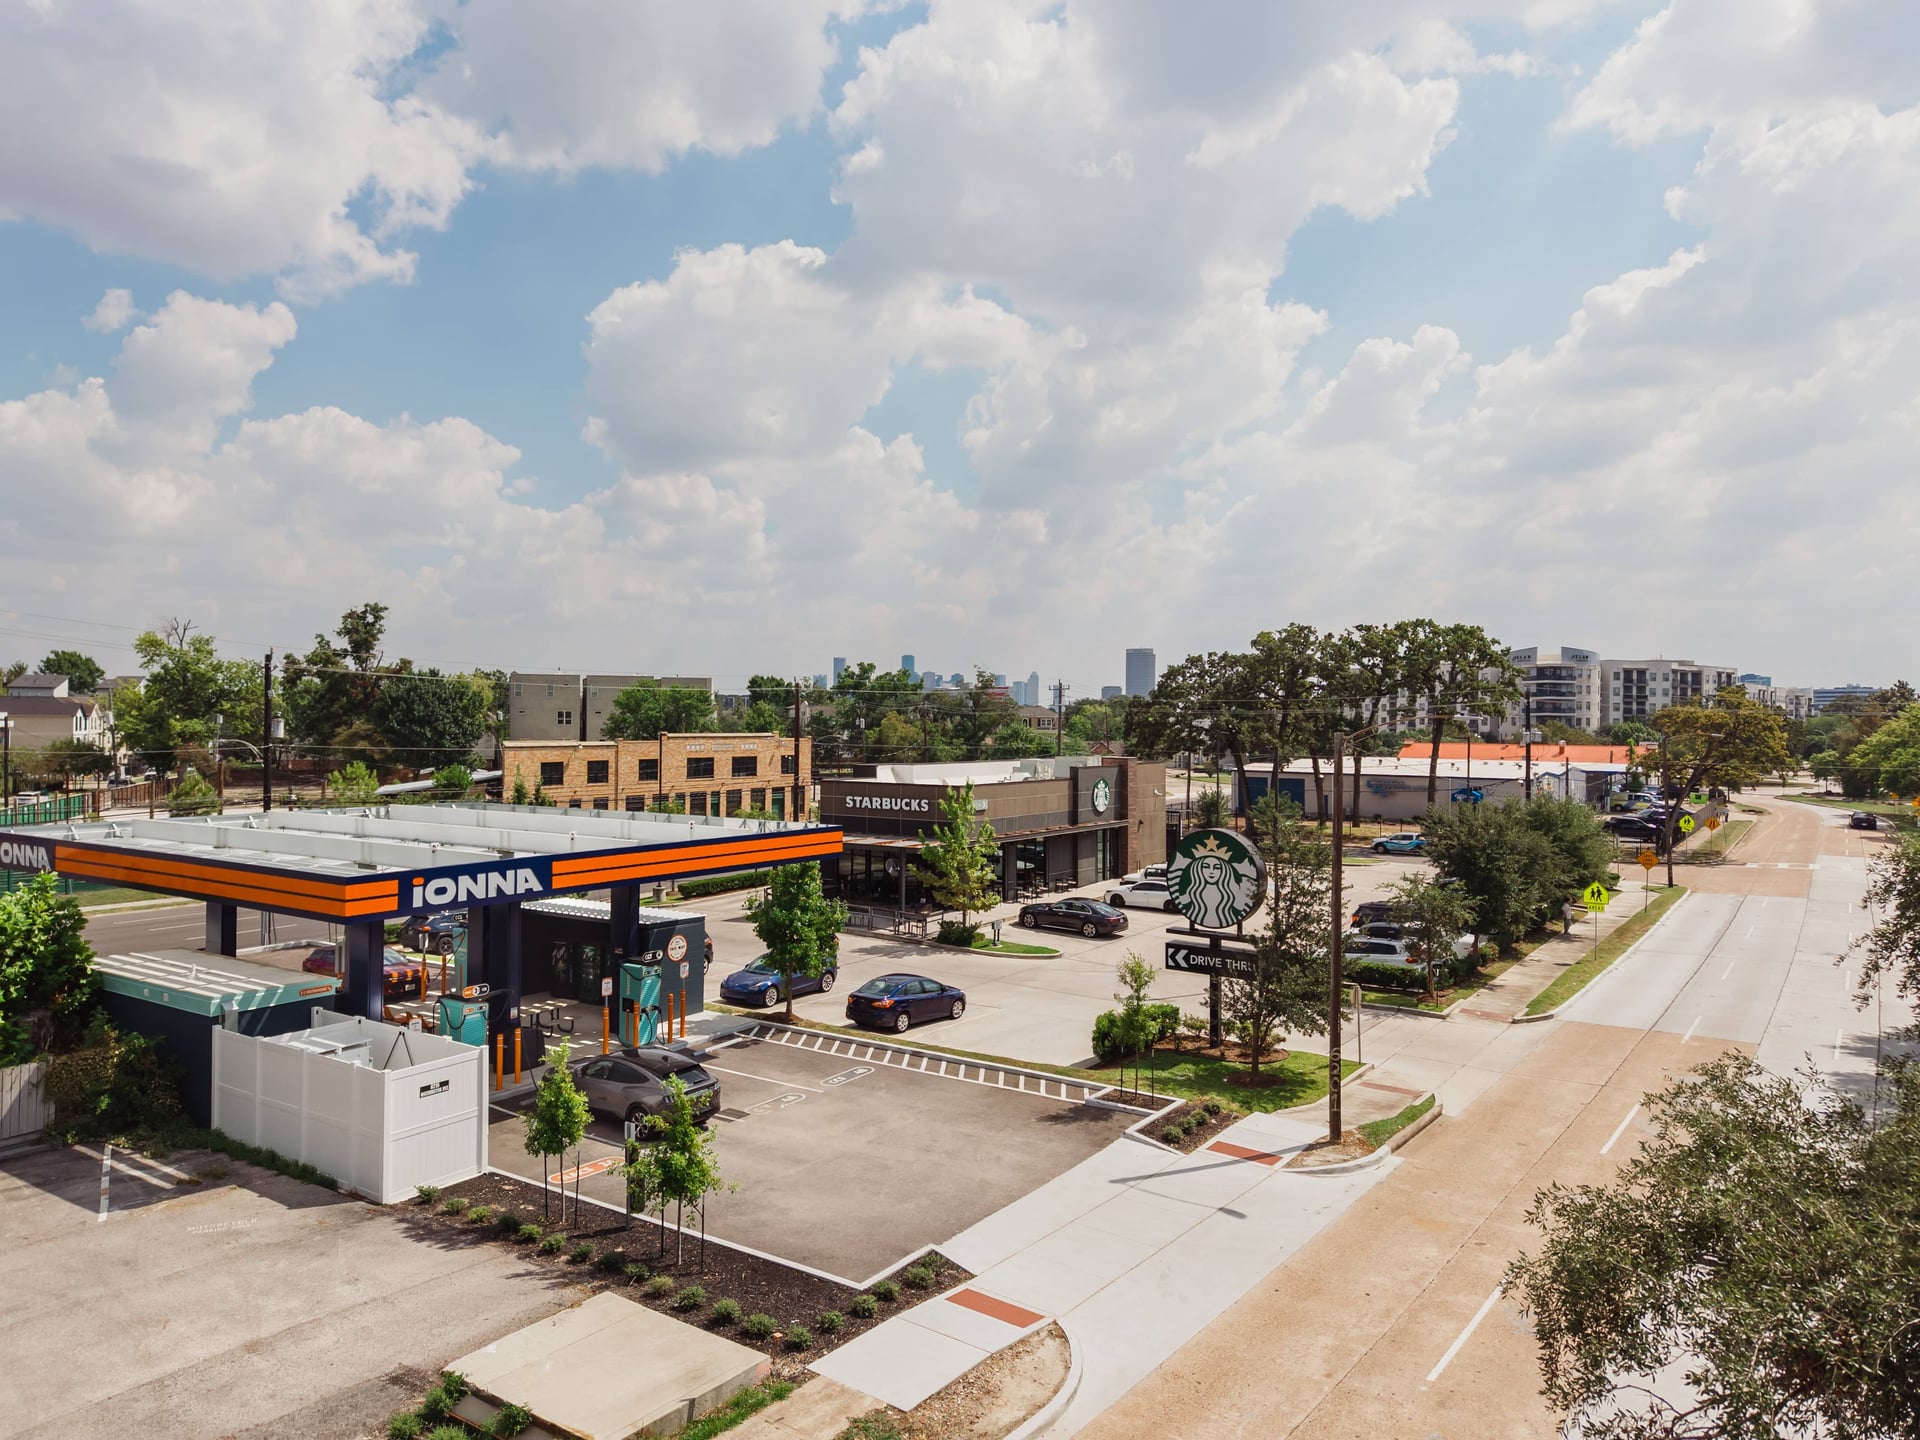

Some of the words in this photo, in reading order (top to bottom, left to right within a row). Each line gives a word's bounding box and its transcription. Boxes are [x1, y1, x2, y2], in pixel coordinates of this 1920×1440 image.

[845, 796, 929, 812] STARBUCKS
[1190, 954, 1222, 968] DRIVE
[1330, 1047, 1340, 1112] 6201
